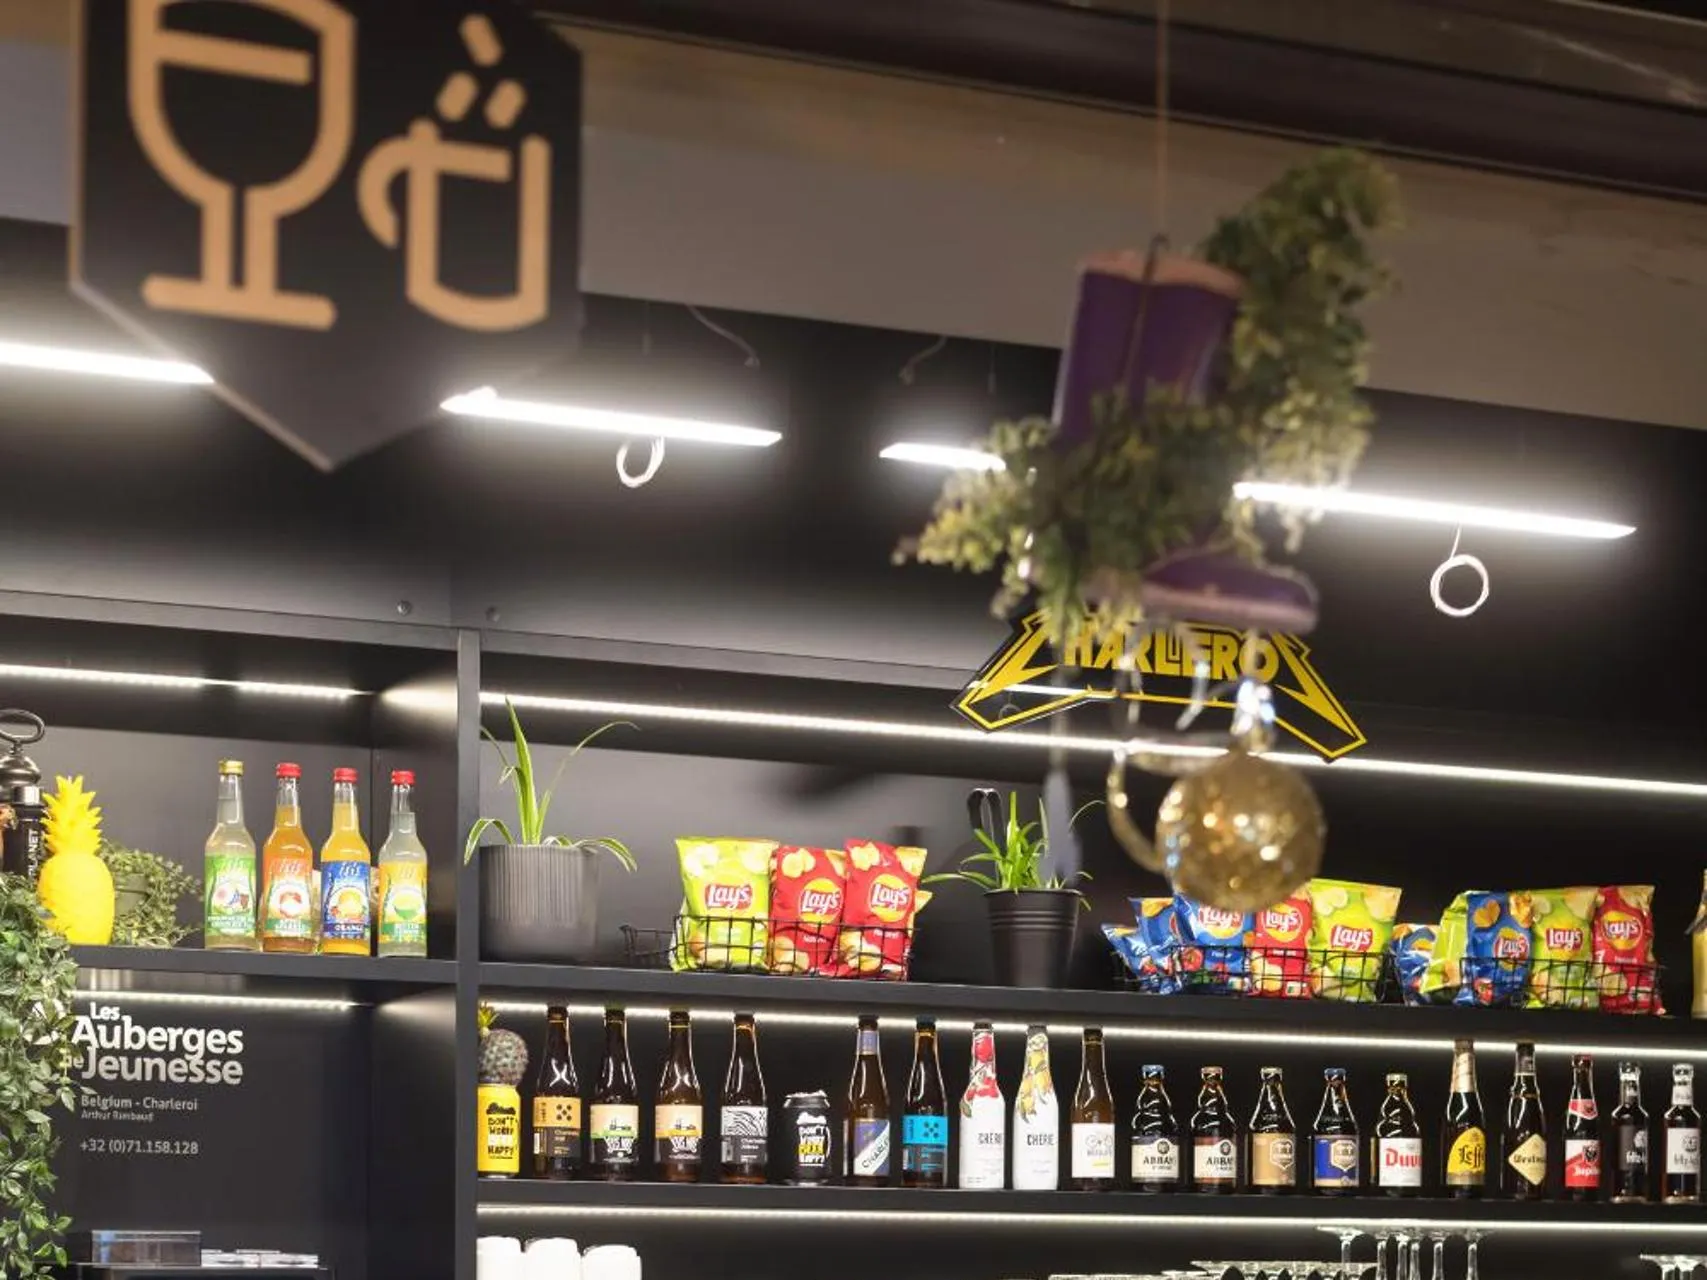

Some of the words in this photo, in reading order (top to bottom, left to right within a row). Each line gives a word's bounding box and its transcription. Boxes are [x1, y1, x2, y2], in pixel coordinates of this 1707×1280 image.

[708, 883, 751, 909] Lay's
[802, 890, 840, 913] Lay's
[871, 881, 910, 906] Lay's
[1265, 909, 1298, 927] Lay's
[1333, 926, 1371, 947] Lay's
[1549, 927, 1581, 951] Lay's
[90, 1002, 120, 1020] Les
[71, 1015, 244, 1060] Auberges
[81, 1046, 243, 1085] Jeunesse
[81, 1095, 132, 1110] Belgium
[142, 1097, 198, 1110] Charleroi
[80, 1138, 105, 1151] +32
[109, 1139, 199, 1155] (0)71.158.128
